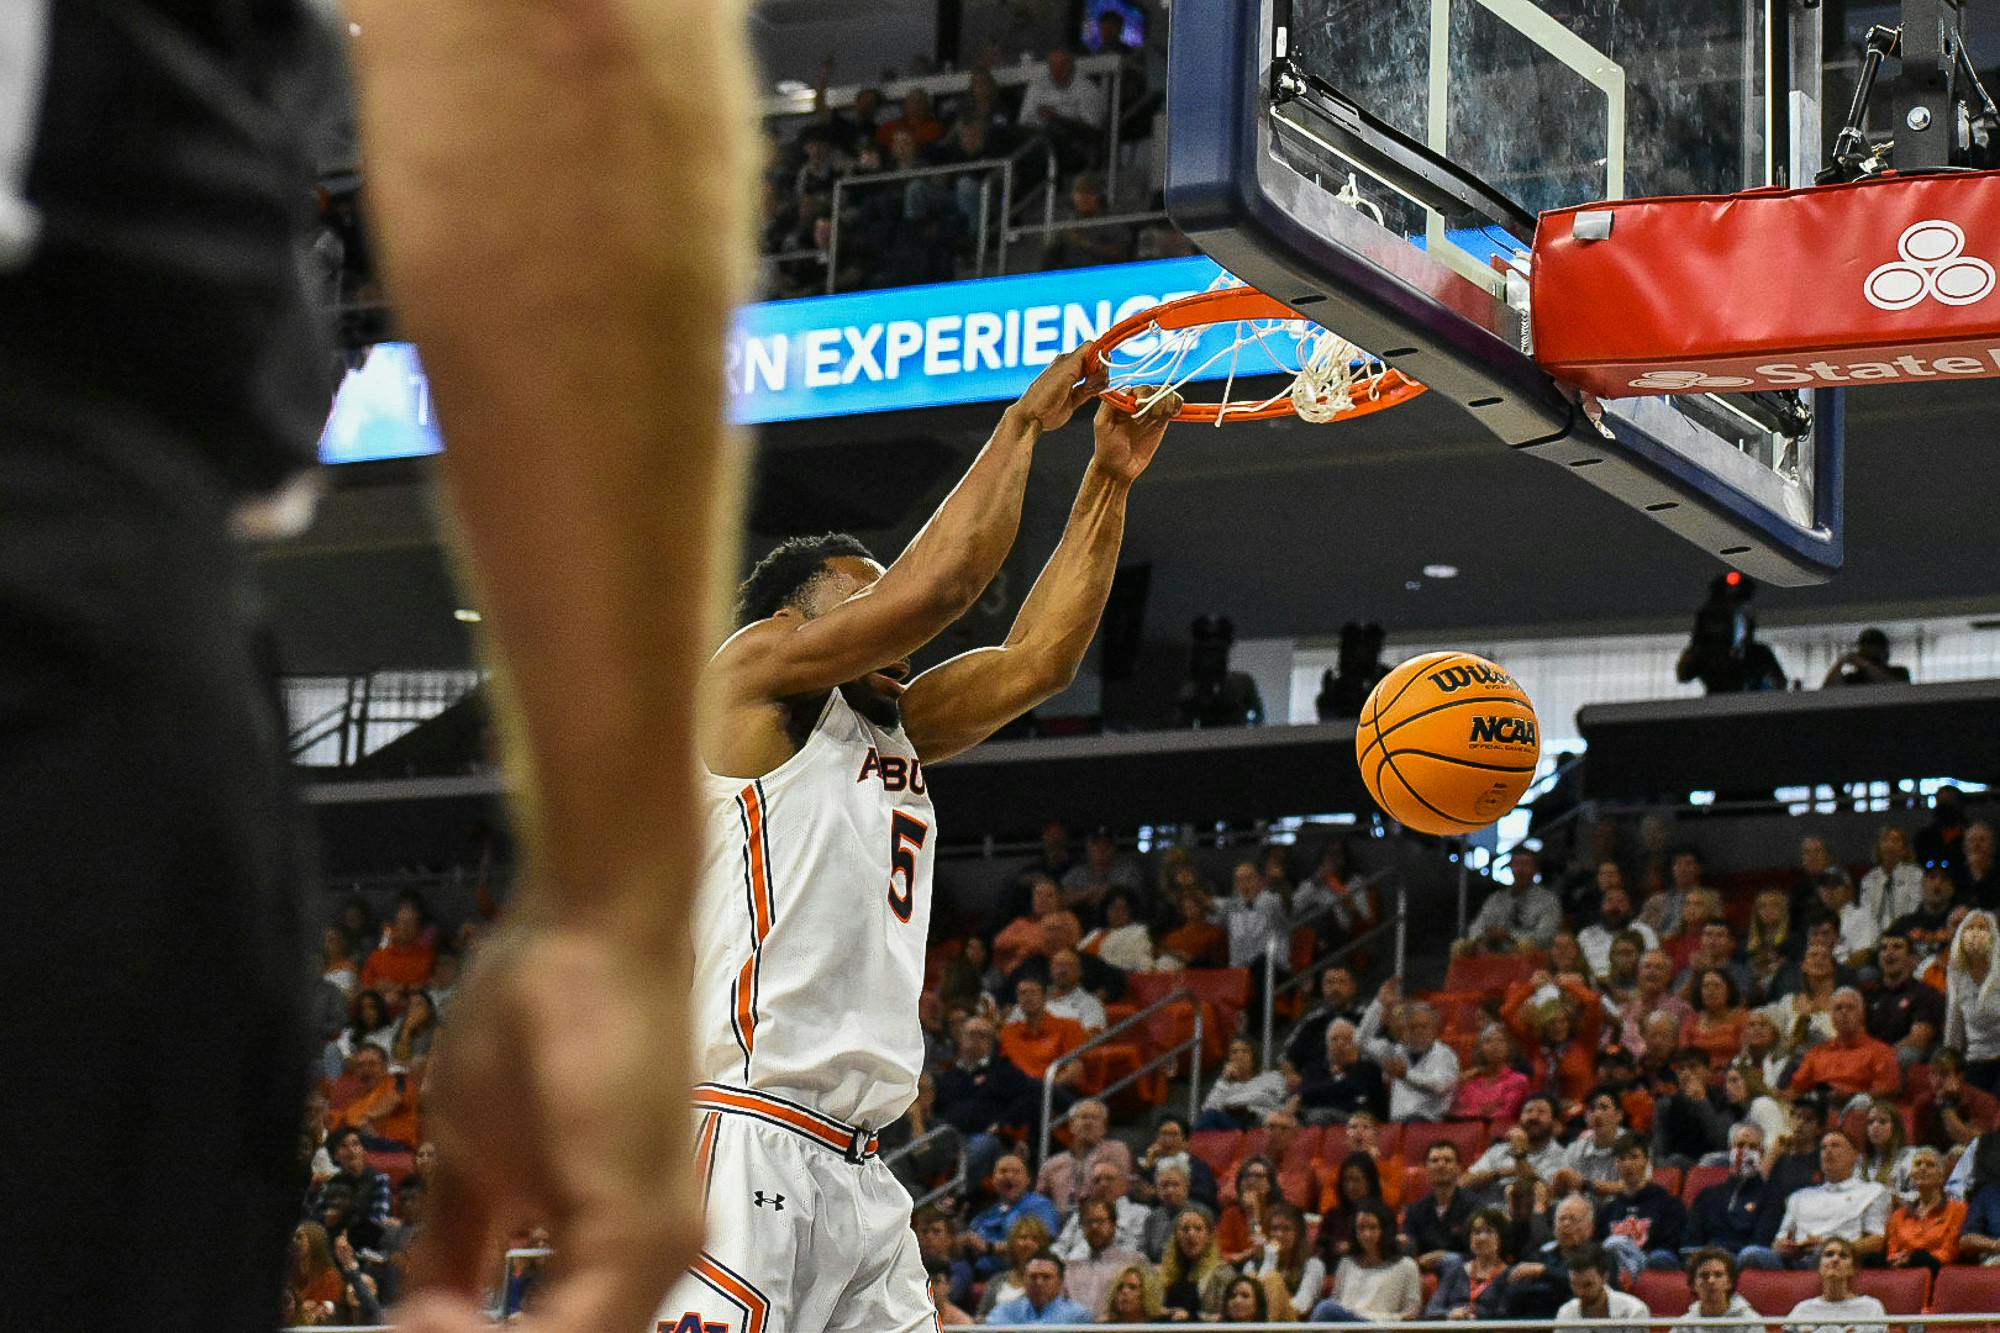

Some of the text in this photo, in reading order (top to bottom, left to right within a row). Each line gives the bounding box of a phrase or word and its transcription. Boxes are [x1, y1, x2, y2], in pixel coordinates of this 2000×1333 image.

[735, 333, 788, 394] N
[1755, 355, 1985, 384] State
[1469, 716, 1536, 746] NCAA
[888, 808, 929, 924] 5
